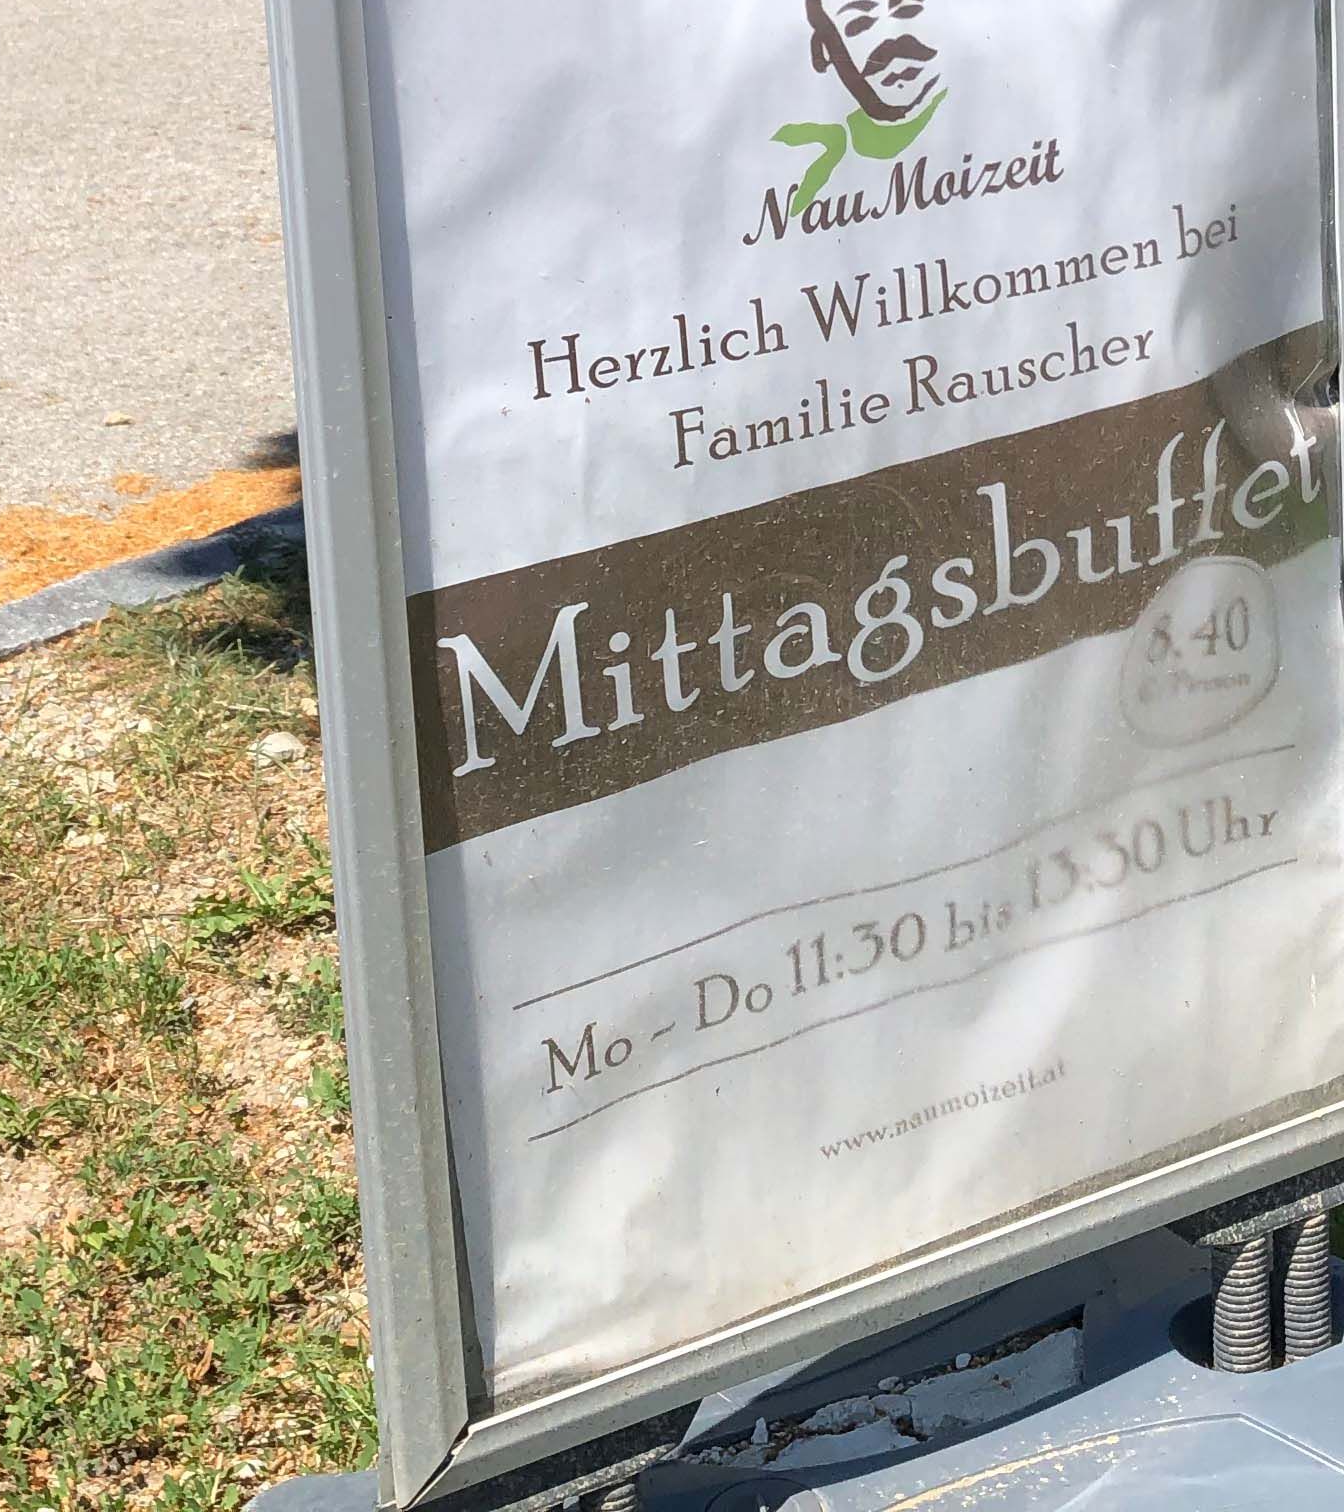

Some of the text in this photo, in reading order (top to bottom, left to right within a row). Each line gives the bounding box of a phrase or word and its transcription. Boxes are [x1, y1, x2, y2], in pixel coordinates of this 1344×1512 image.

[527, 203, 1240, 400] Herzlich Willkommen bei
[668, 320, 1155, 470] Familie Rauscher
[433, 406, 1322, 777] Mittagsbuffet
[541, 1020, 634, 1094] Mo
[693, 973, 774, 1032] Do
[785, 911, 928, 997] 11:30
[943, 900, 1013, 953] bis
[1179, 794, 1280, 858] Uhr
